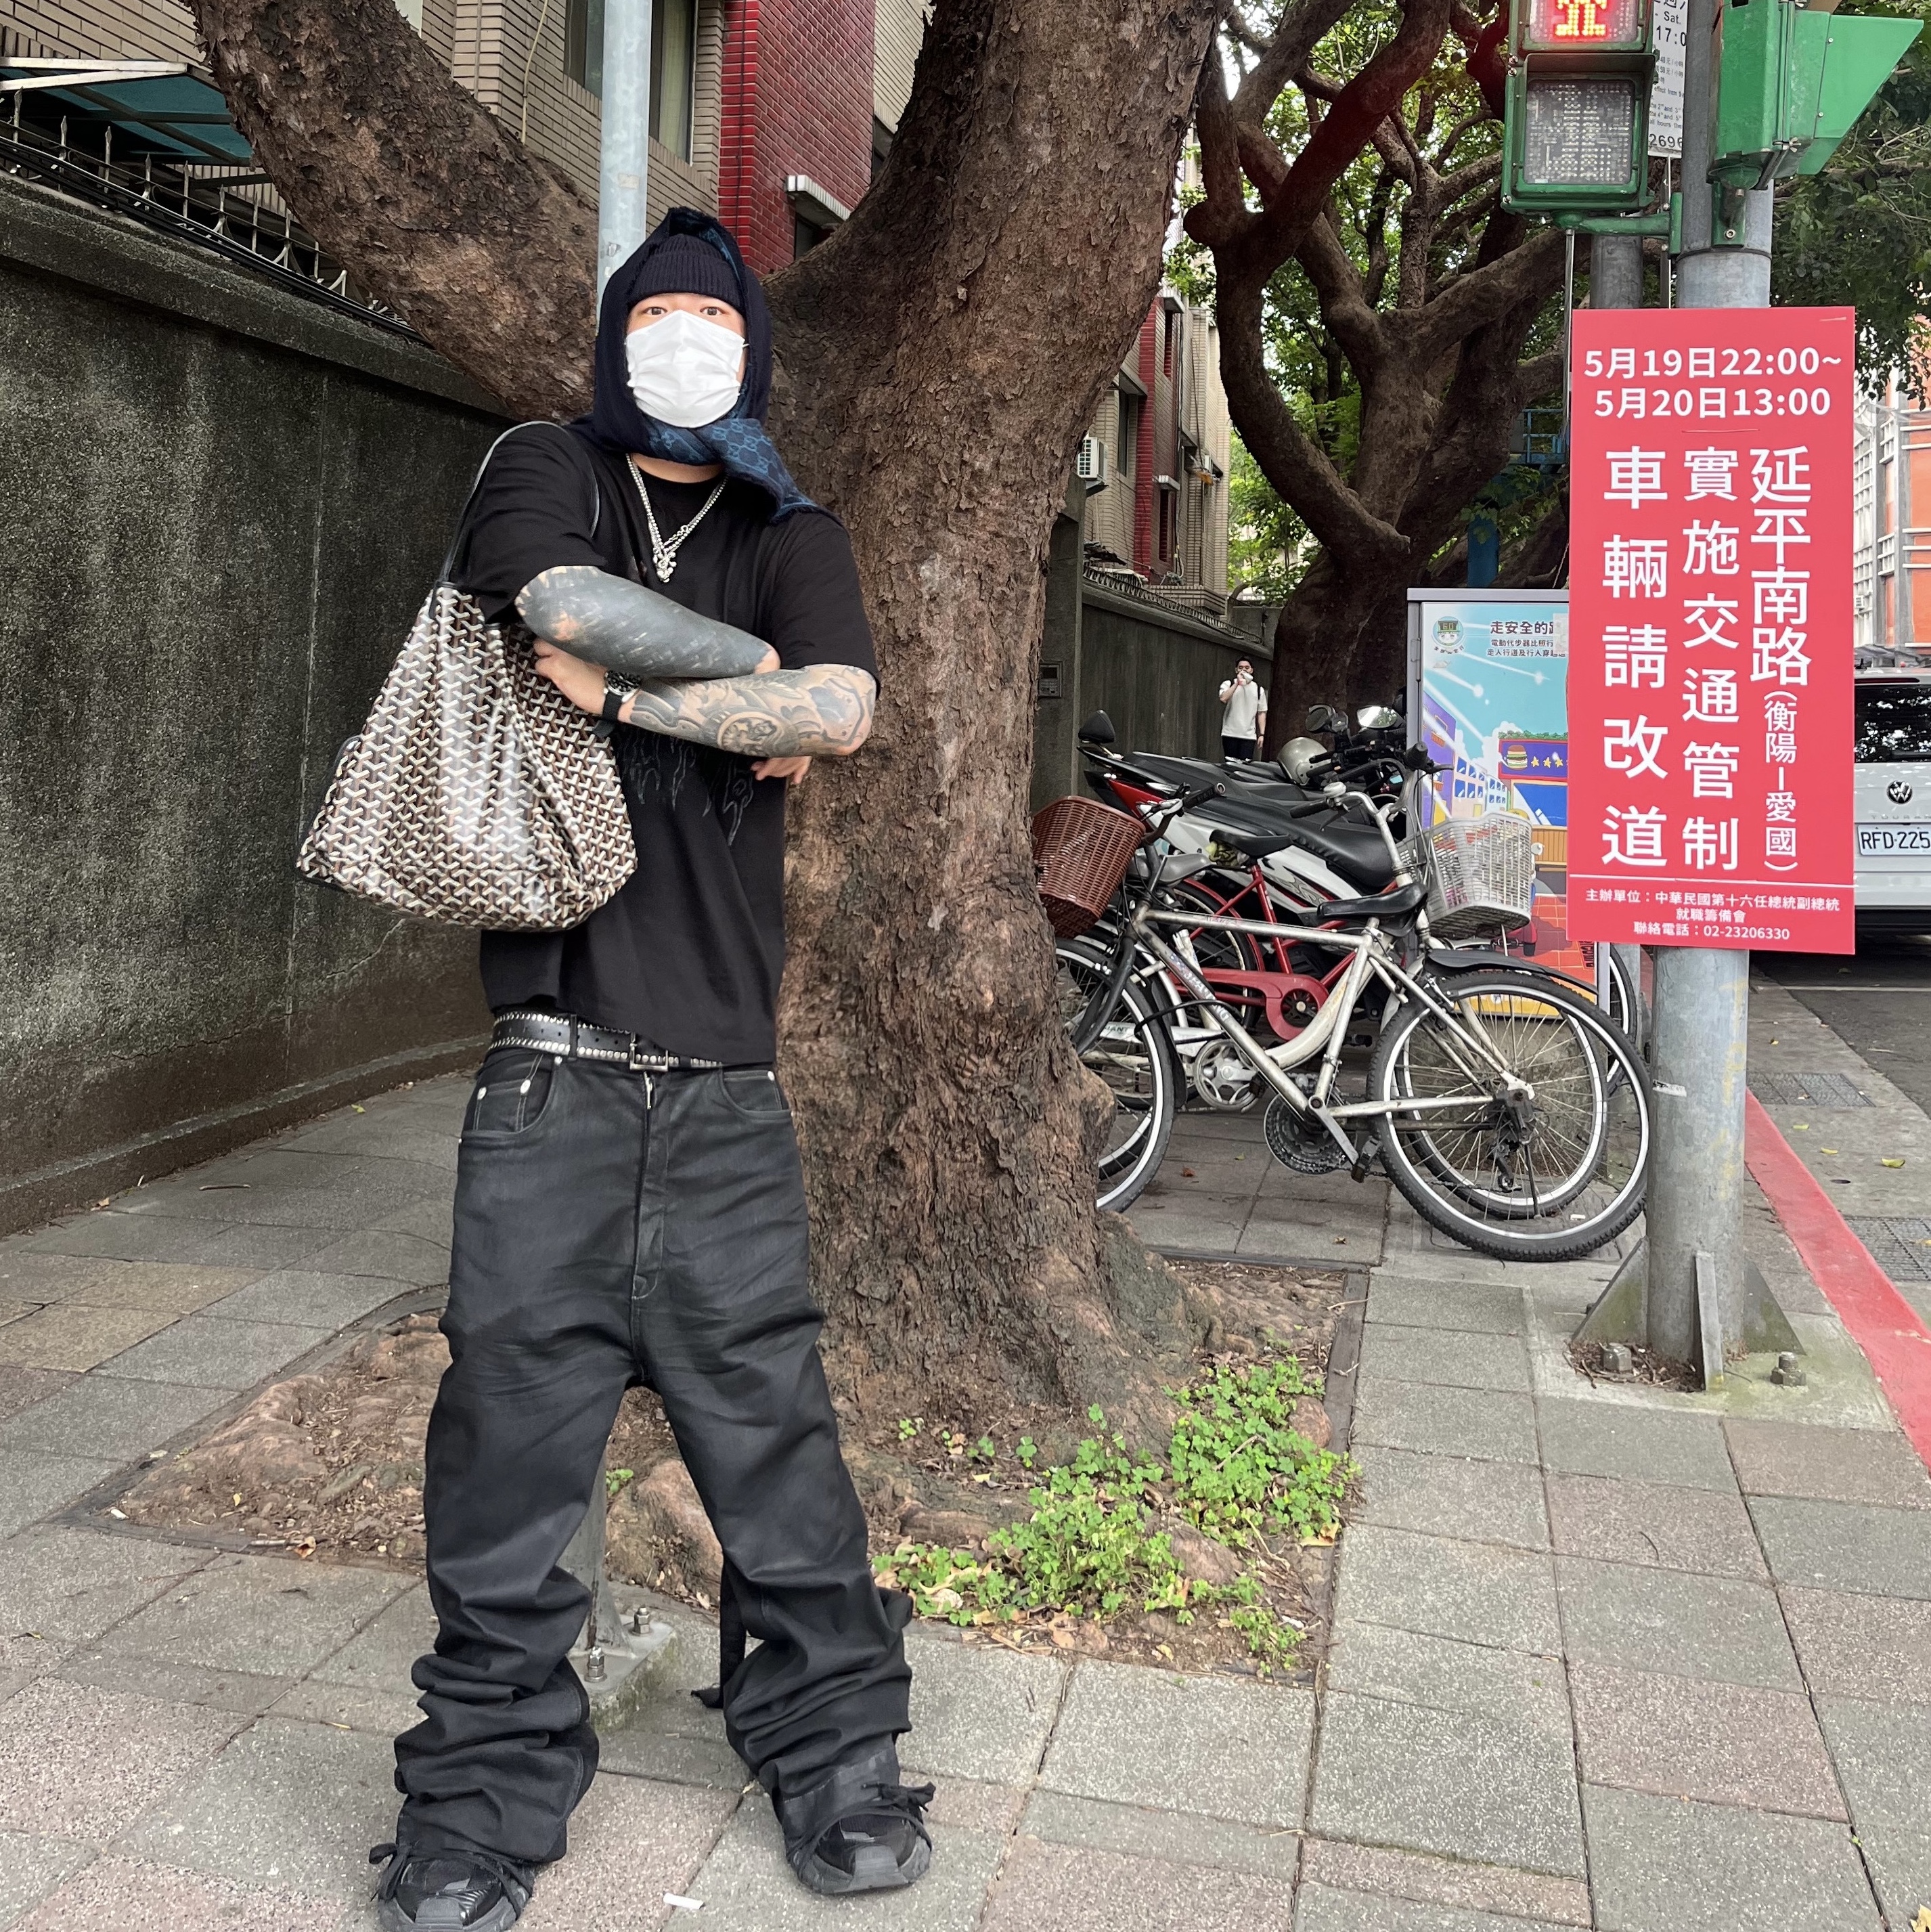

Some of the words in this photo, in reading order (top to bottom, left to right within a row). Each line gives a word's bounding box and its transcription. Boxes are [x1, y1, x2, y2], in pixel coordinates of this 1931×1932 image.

[1584, 347, 1842, 379] 5月19日22:00~
[1594, 387, 1830, 418] 5月20日13:00
[1601, 445, 1668, 867] 車輛請改道
[1681, 445, 1740, 871] 實施交通管制
[1675, 907, 1747, 924] 就職籌備會
